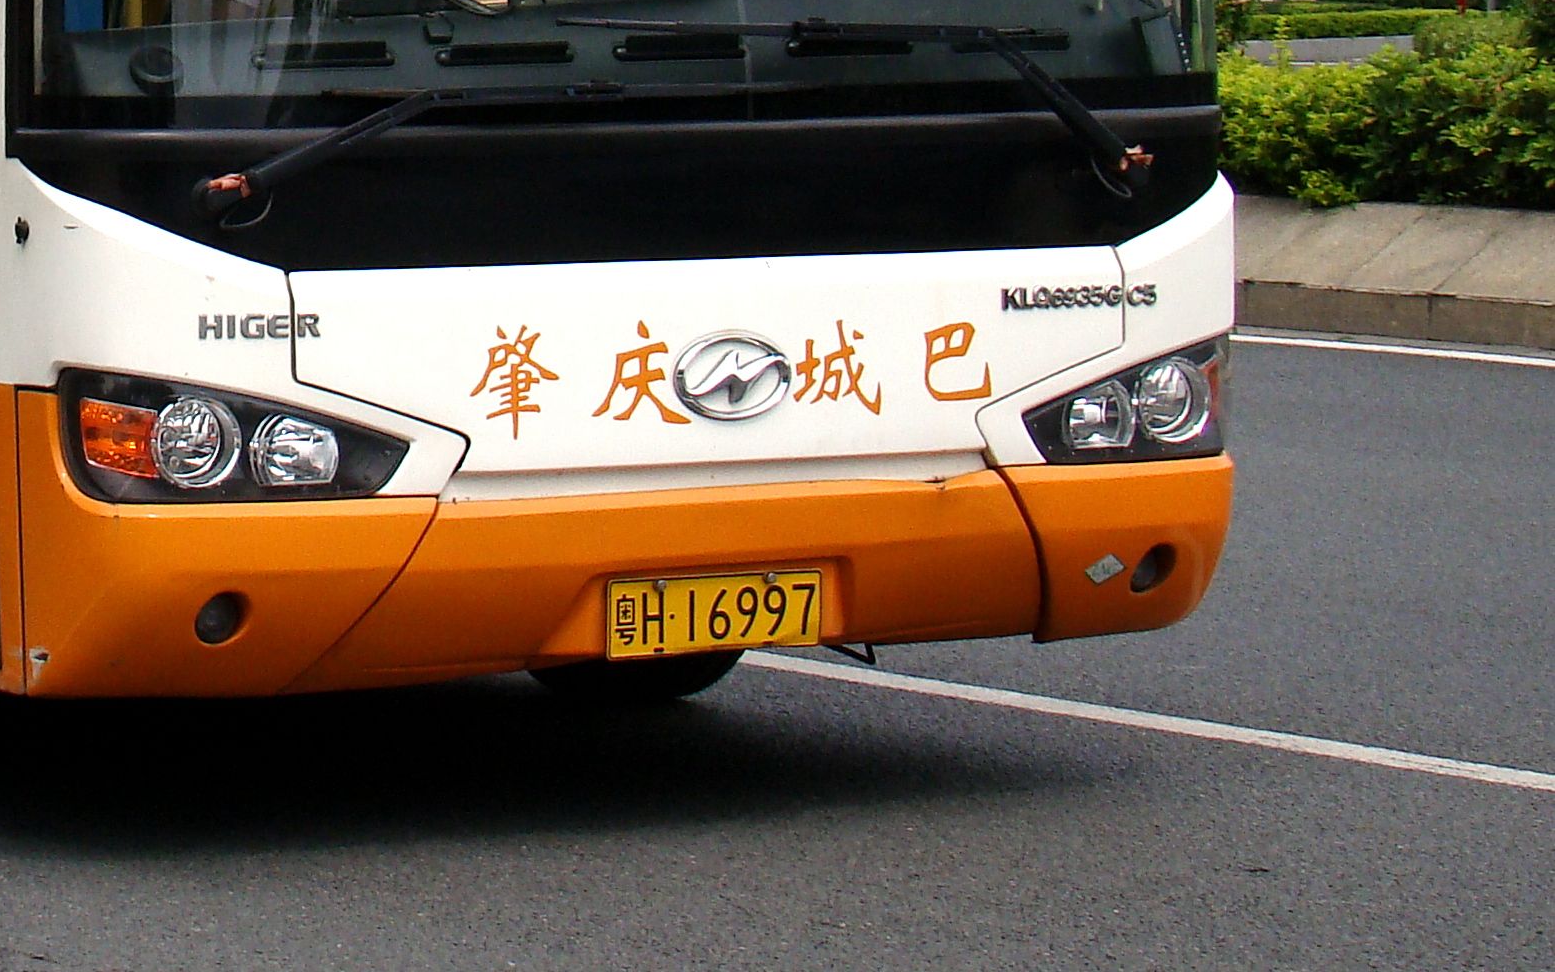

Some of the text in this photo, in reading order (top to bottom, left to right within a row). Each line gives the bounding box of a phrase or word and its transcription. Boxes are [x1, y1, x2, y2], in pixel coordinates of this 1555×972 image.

[198, 313, 321, 339] HIGER
[469, 319, 993, 440] 肇庆城巴
